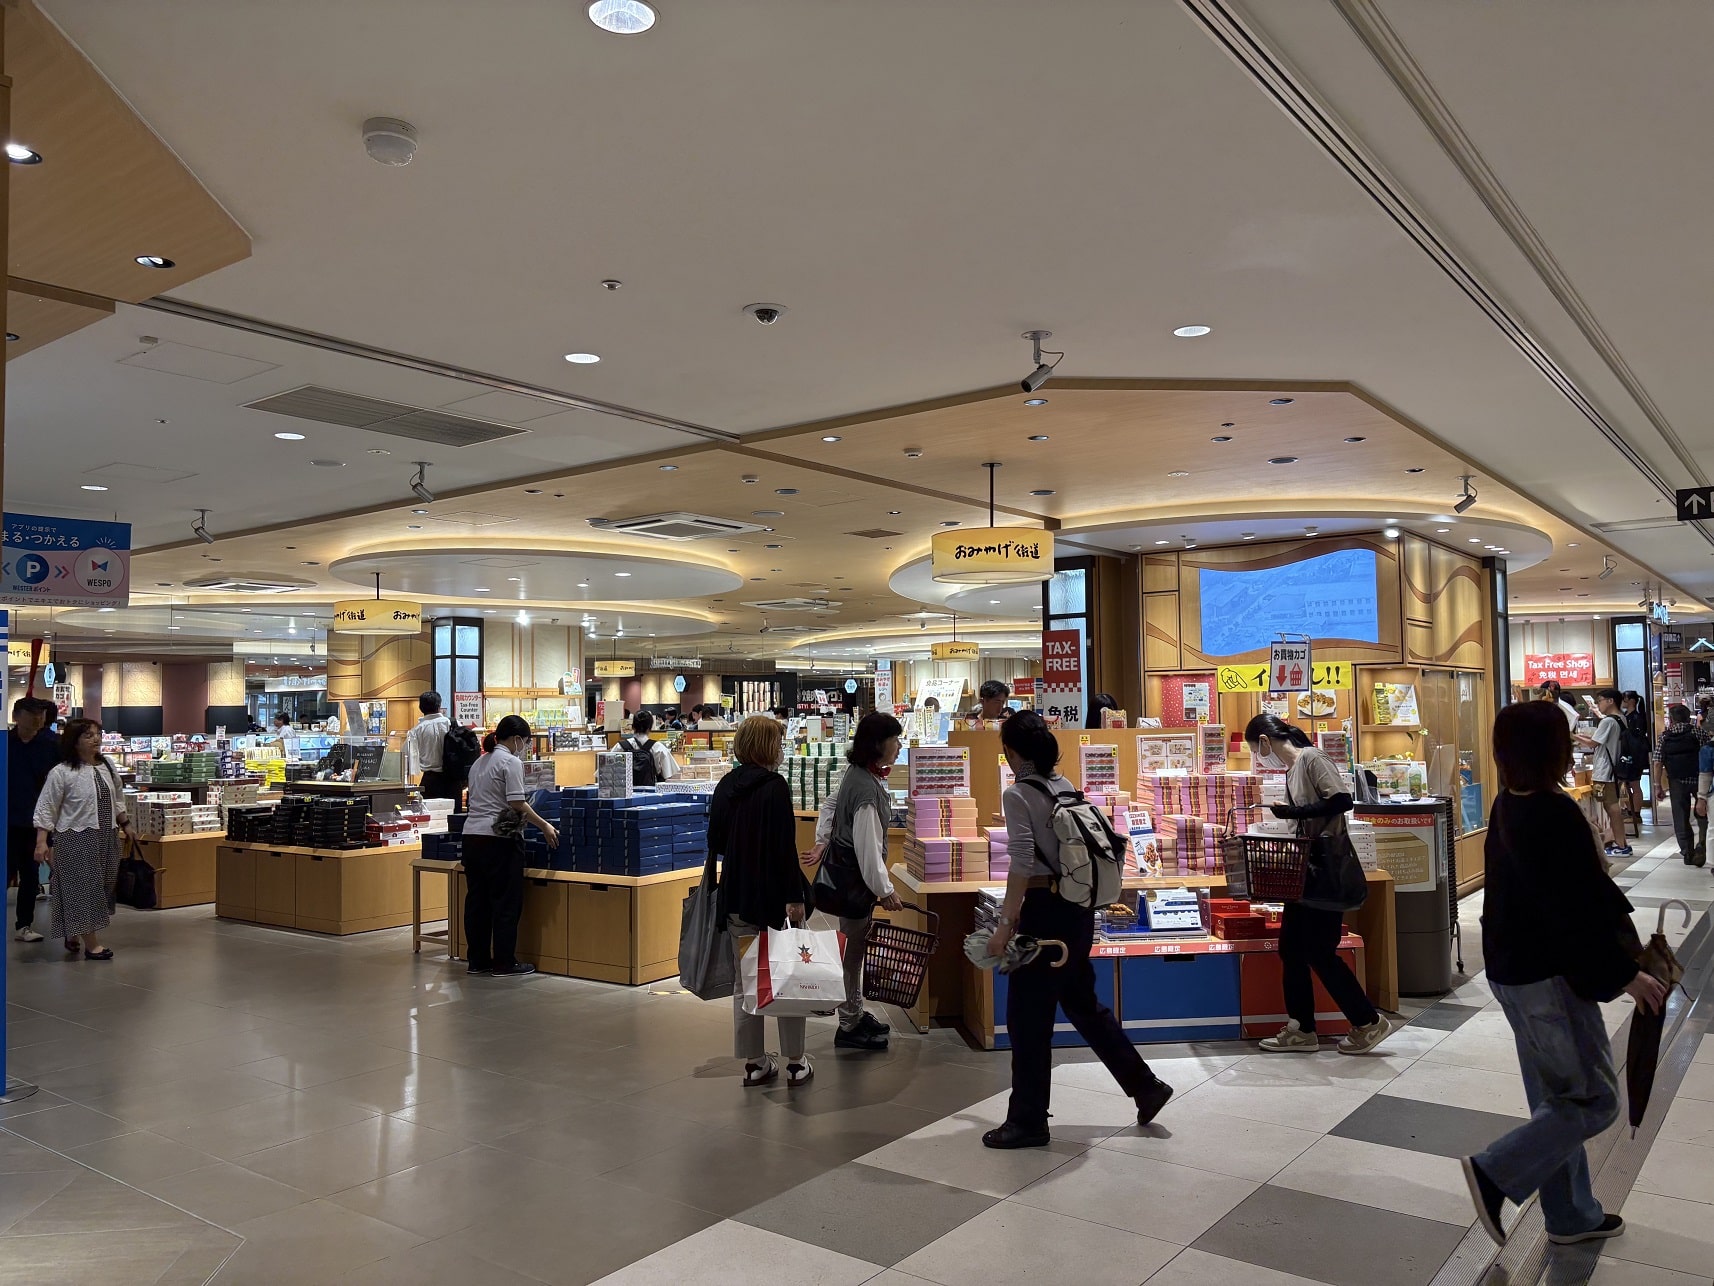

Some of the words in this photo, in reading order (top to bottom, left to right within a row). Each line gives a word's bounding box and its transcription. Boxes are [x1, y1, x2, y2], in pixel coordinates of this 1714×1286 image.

[954, 540, 1041, 560] おみやげ街道
[87, 578, 112, 588] WESPO
[1046, 641, 1076, 655] TAX-
[1273, 648, 1307, 661] お買物カゴ
[1046, 657, 1078, 672] FREE
[1528, 660, 1543, 669] Tax
[1545, 659, 1565, 669] Free
[1566, 659, 1590, 669] Shop
